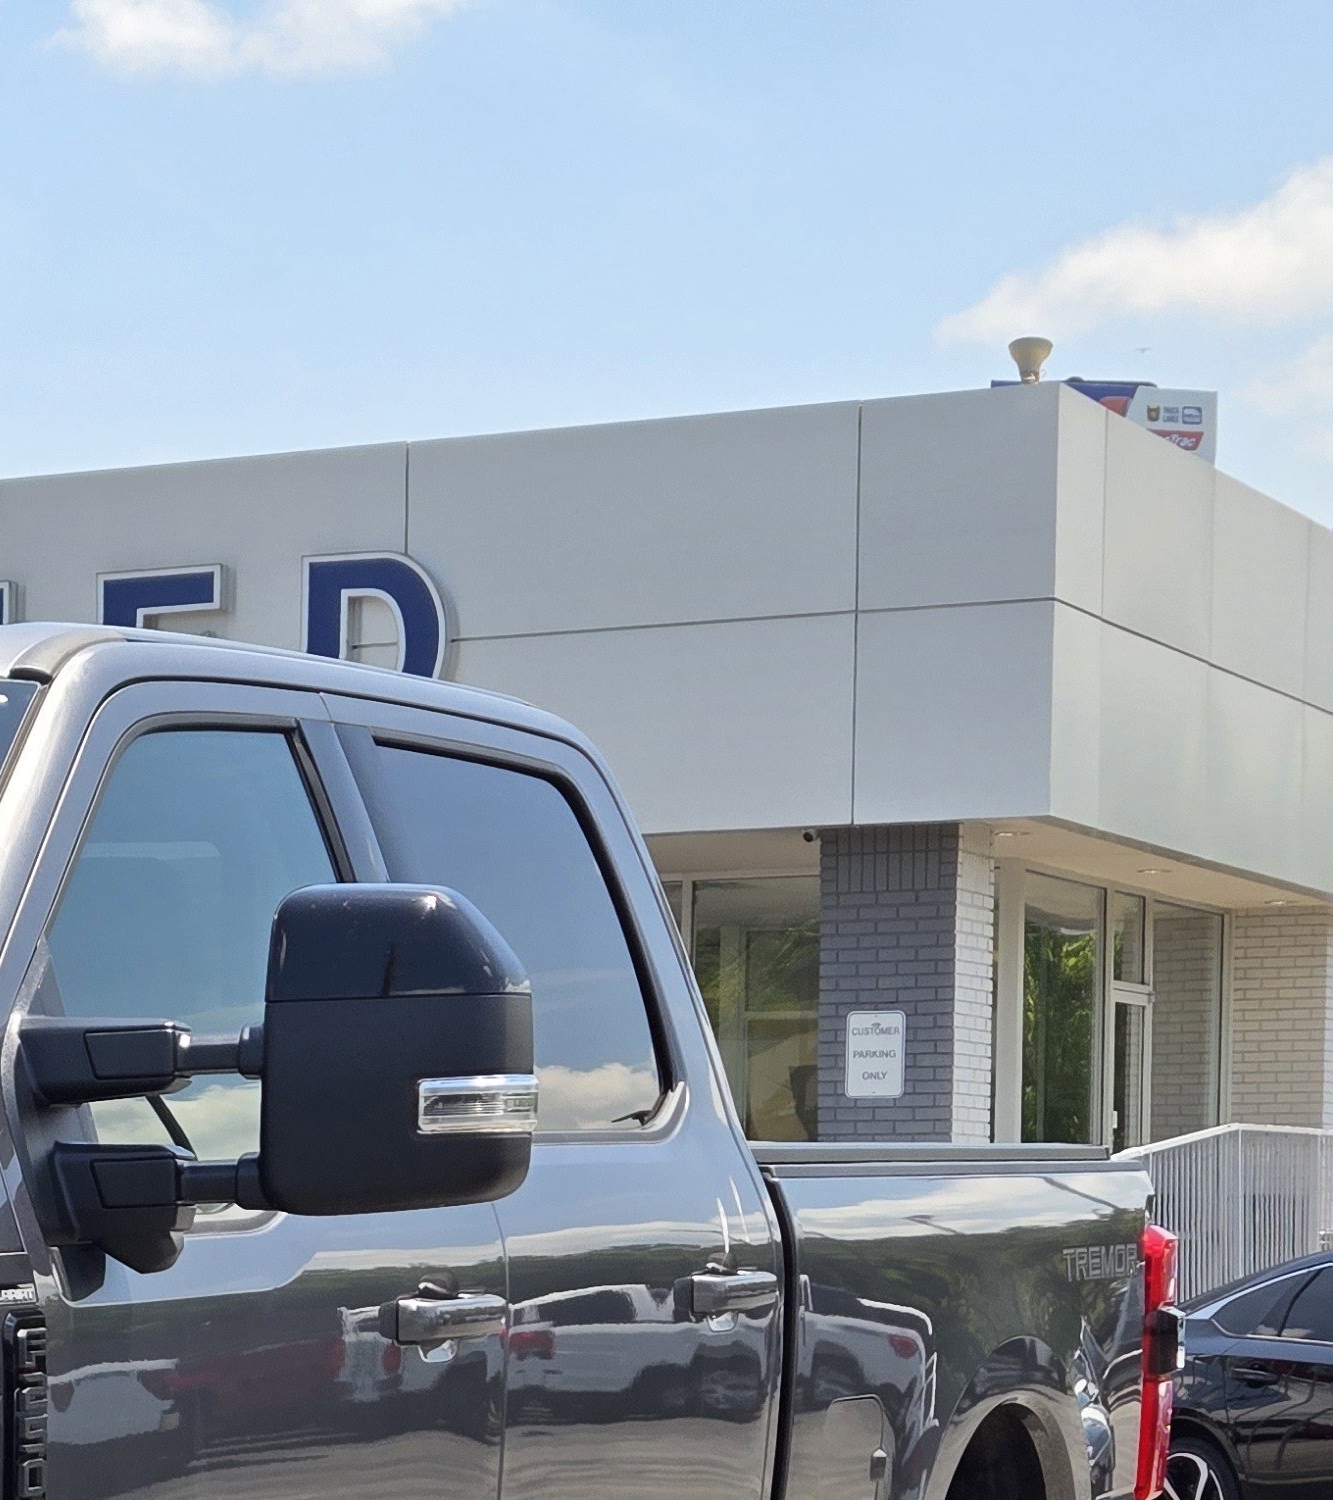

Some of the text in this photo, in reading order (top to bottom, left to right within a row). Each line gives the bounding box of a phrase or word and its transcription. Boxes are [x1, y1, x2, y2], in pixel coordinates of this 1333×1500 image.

[851, 1026, 900, 1037] CUSTOMER
[852, 1049, 896, 1059] PARKING
[861, 1071, 887, 1081] ONLY
[1062, 1242, 1138, 1282] TREMOR
